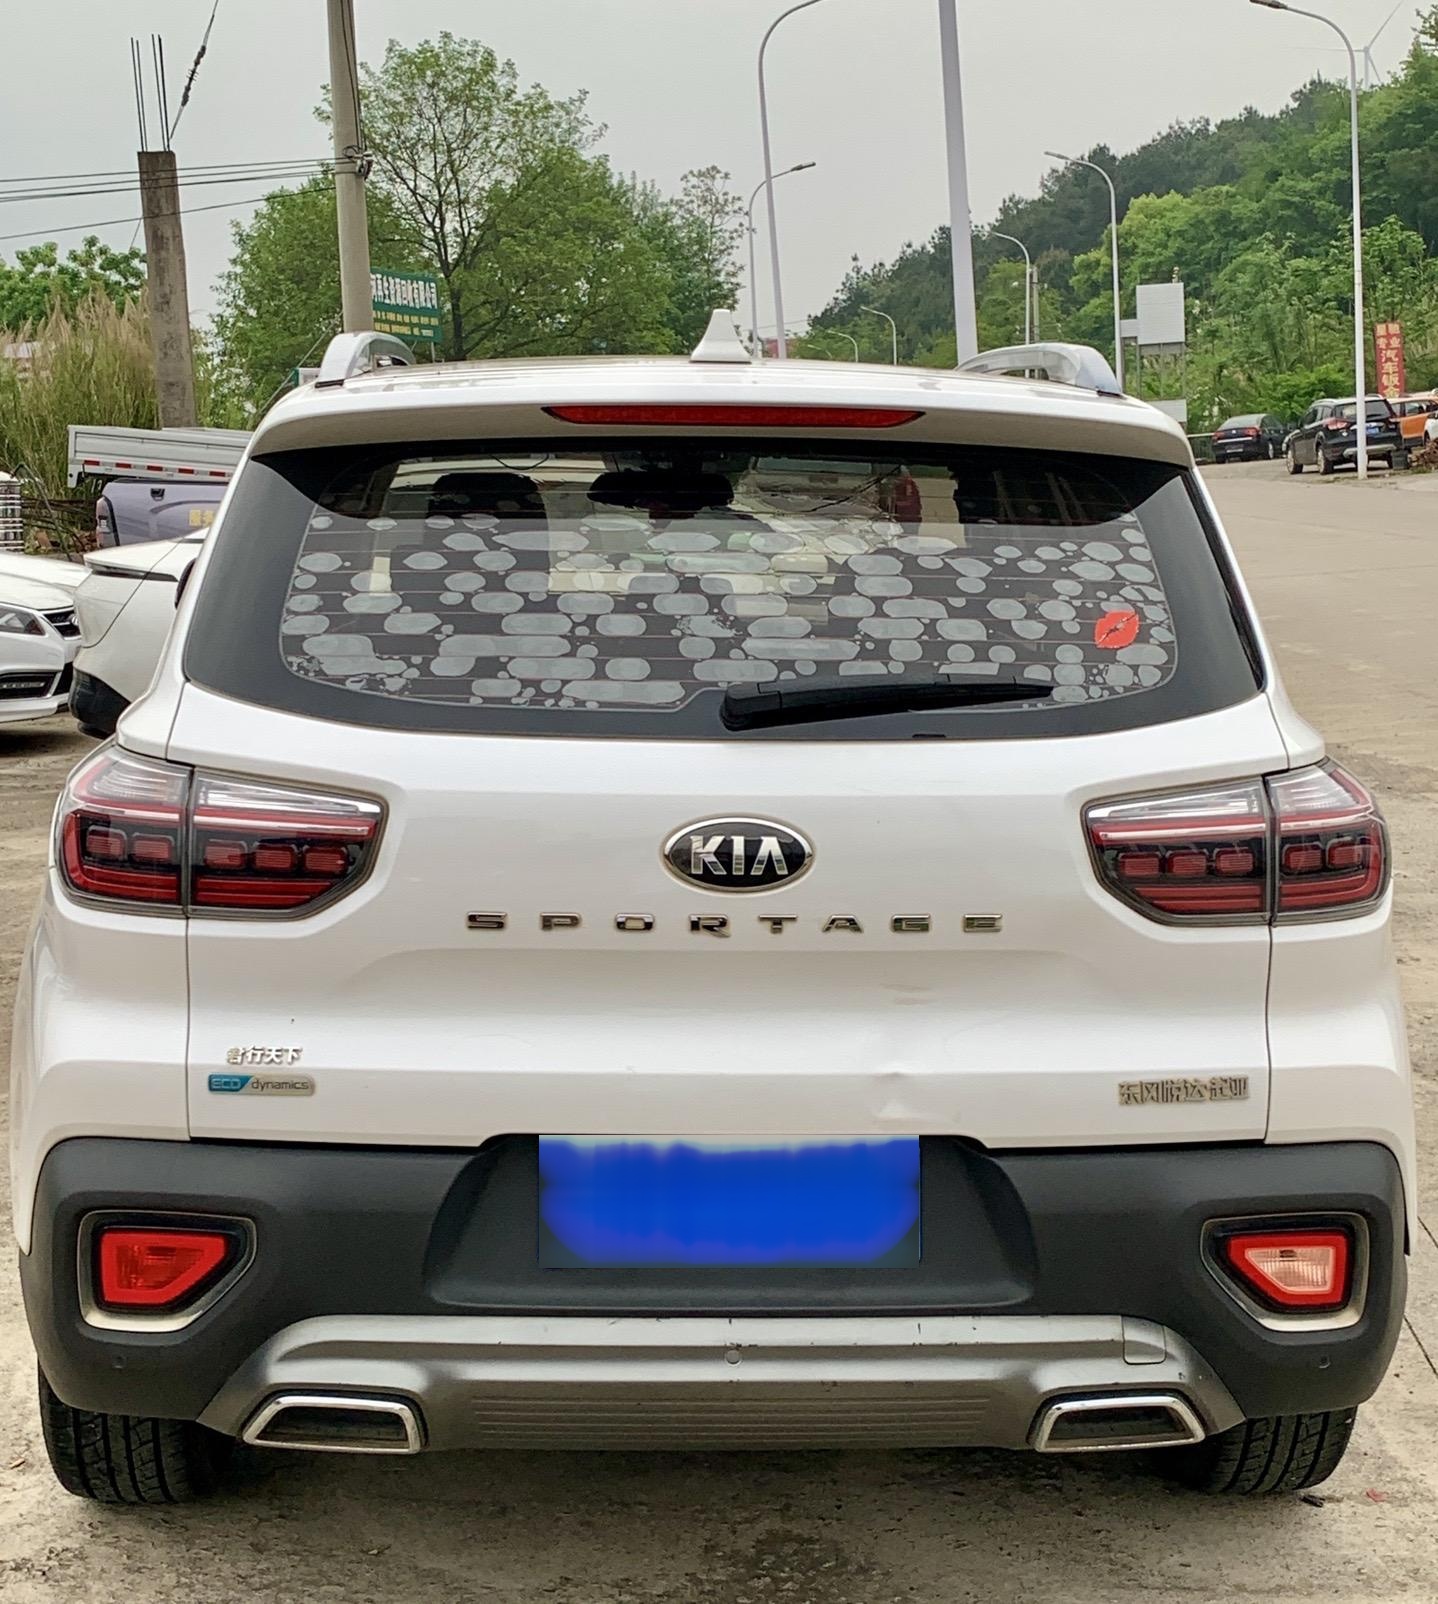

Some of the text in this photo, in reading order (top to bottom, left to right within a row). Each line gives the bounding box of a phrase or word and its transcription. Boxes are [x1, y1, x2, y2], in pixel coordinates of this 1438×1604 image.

[690, 835, 790, 876] KIA
[466, 910, 1003, 937] SPORTAGE
[210, 1078, 309, 1092] ECO dynamics
[1118, 1074, 1249, 1106] 东风悦达起亚
